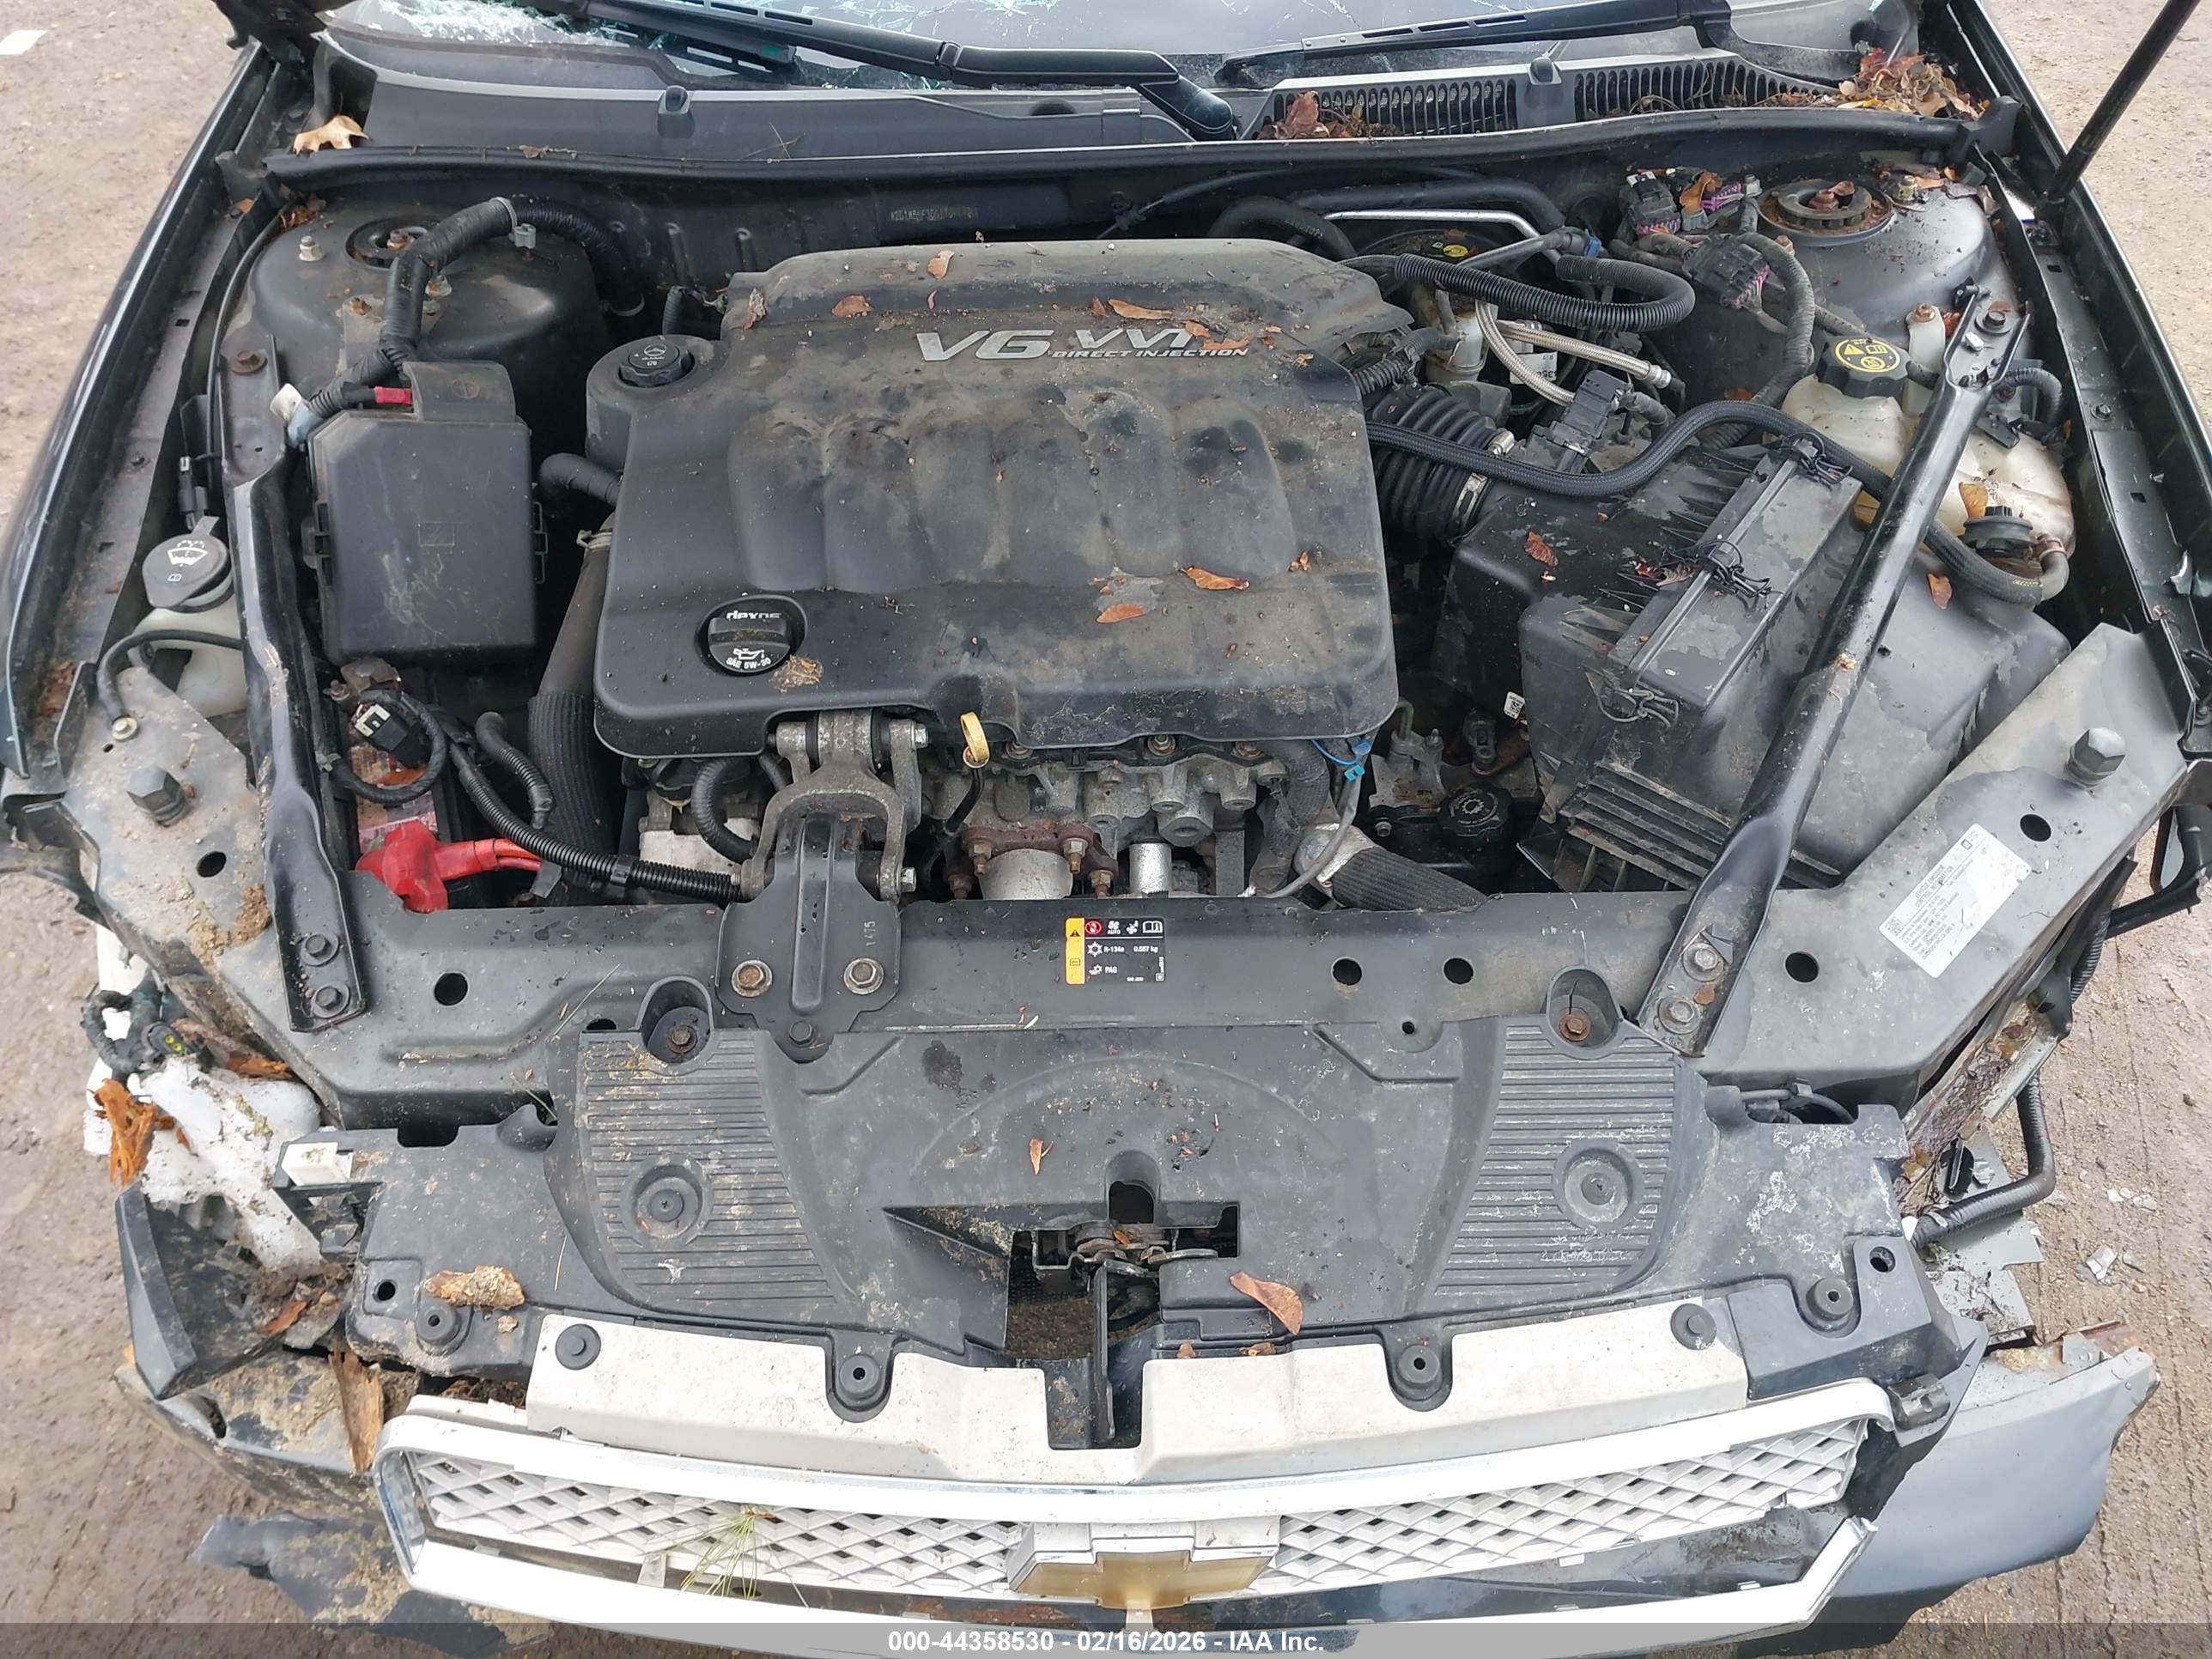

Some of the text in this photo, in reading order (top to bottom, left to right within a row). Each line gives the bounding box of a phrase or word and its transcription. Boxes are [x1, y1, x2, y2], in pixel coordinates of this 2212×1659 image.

[916, 330, 1054, 361] V6
[1135, 349, 1249, 357] INJECTION
[726, 657, 772, 670] SAE 5W-30
